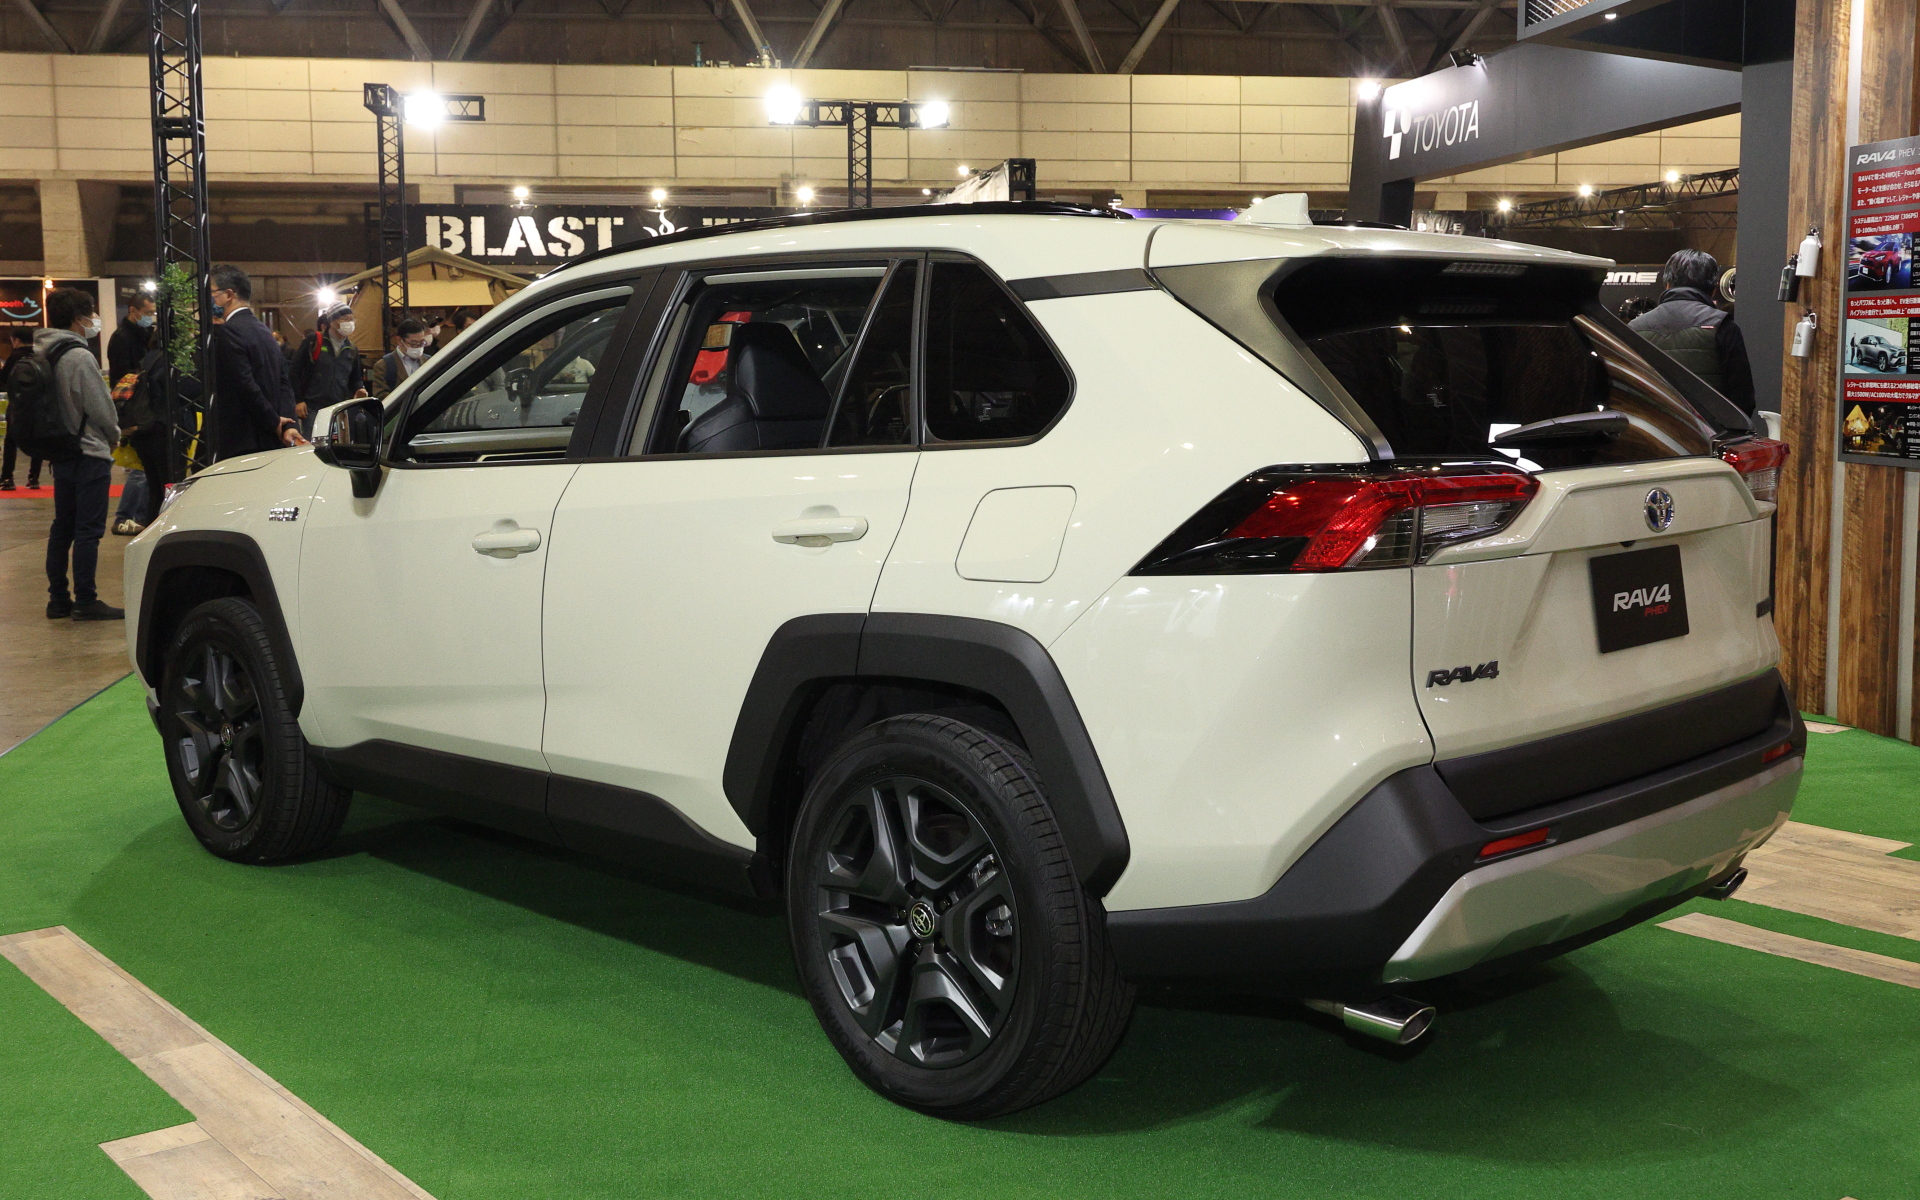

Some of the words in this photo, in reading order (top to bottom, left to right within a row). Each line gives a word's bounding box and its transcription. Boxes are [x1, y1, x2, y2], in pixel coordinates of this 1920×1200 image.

[1413, 99, 1479, 155] TOYOTA
[1856, 149, 1897, 165] RAV4
[1898, 147, 1916, 158] PHEV
[424, 215, 625, 257] BLAST
[1613, 583, 1672, 613] RAV4
[1643, 603, 1670, 617] PHEV
[1426, 660, 1500, 688] RAV4
